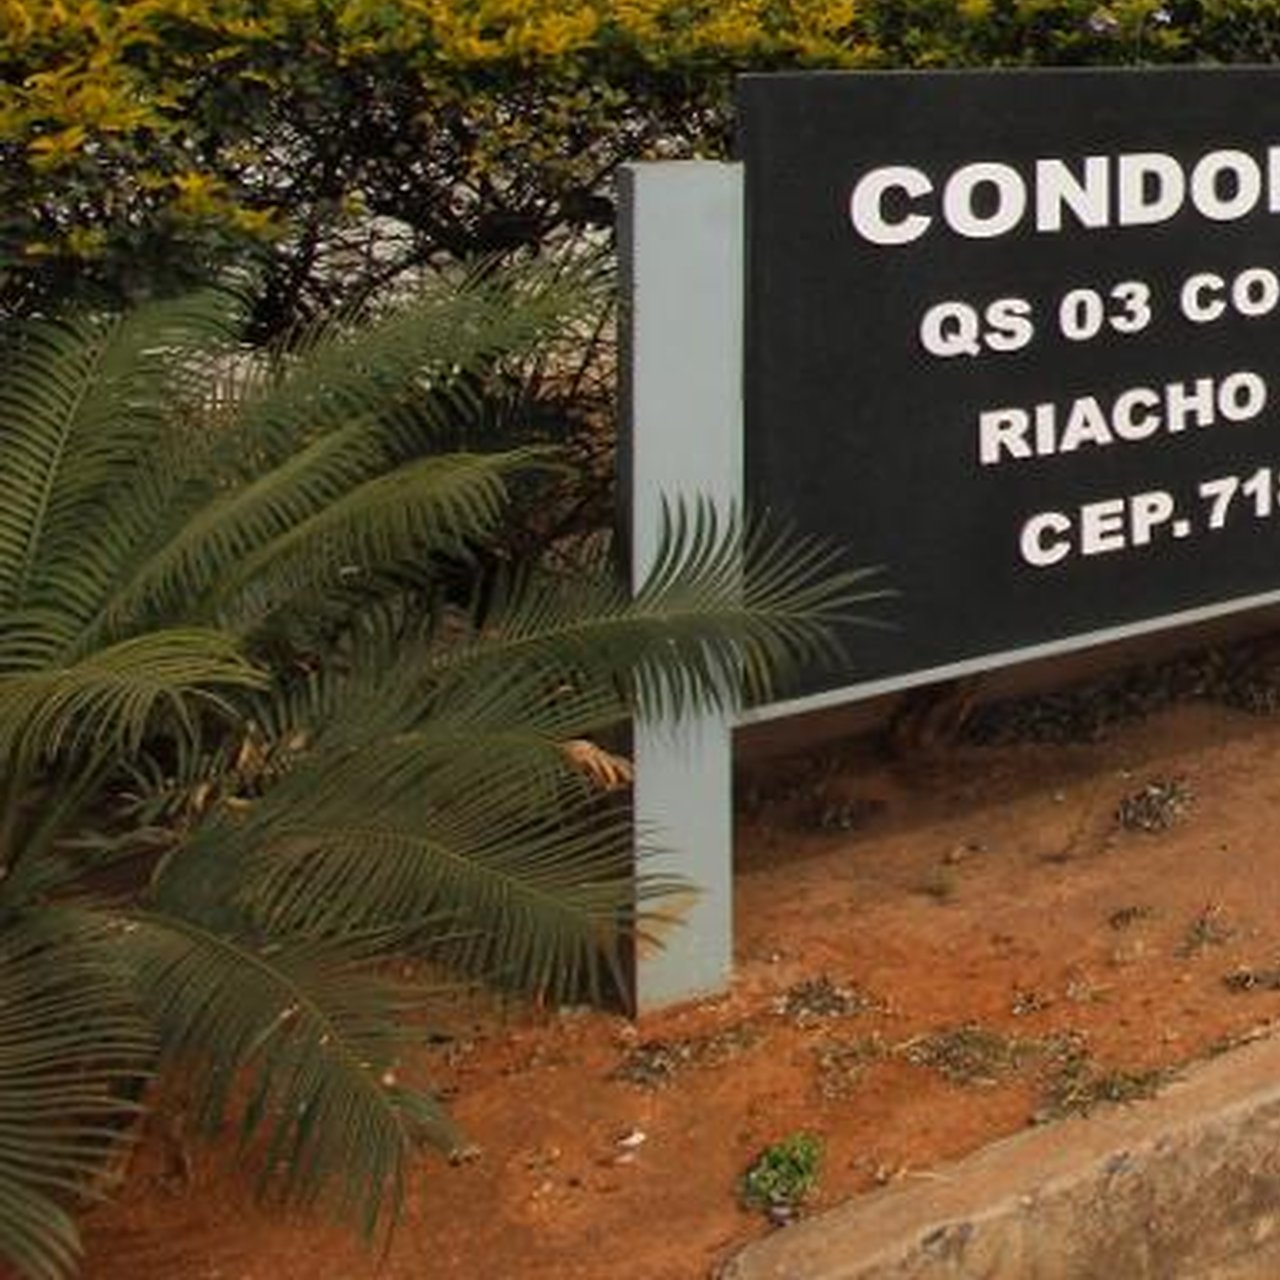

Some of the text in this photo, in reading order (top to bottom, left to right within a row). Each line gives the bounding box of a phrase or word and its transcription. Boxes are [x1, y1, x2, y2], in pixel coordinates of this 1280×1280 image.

[919, 300, 1035, 357] QS
[1058, 281, 1152, 341] 03
[978, 371, 1267, 465] RIACHO
